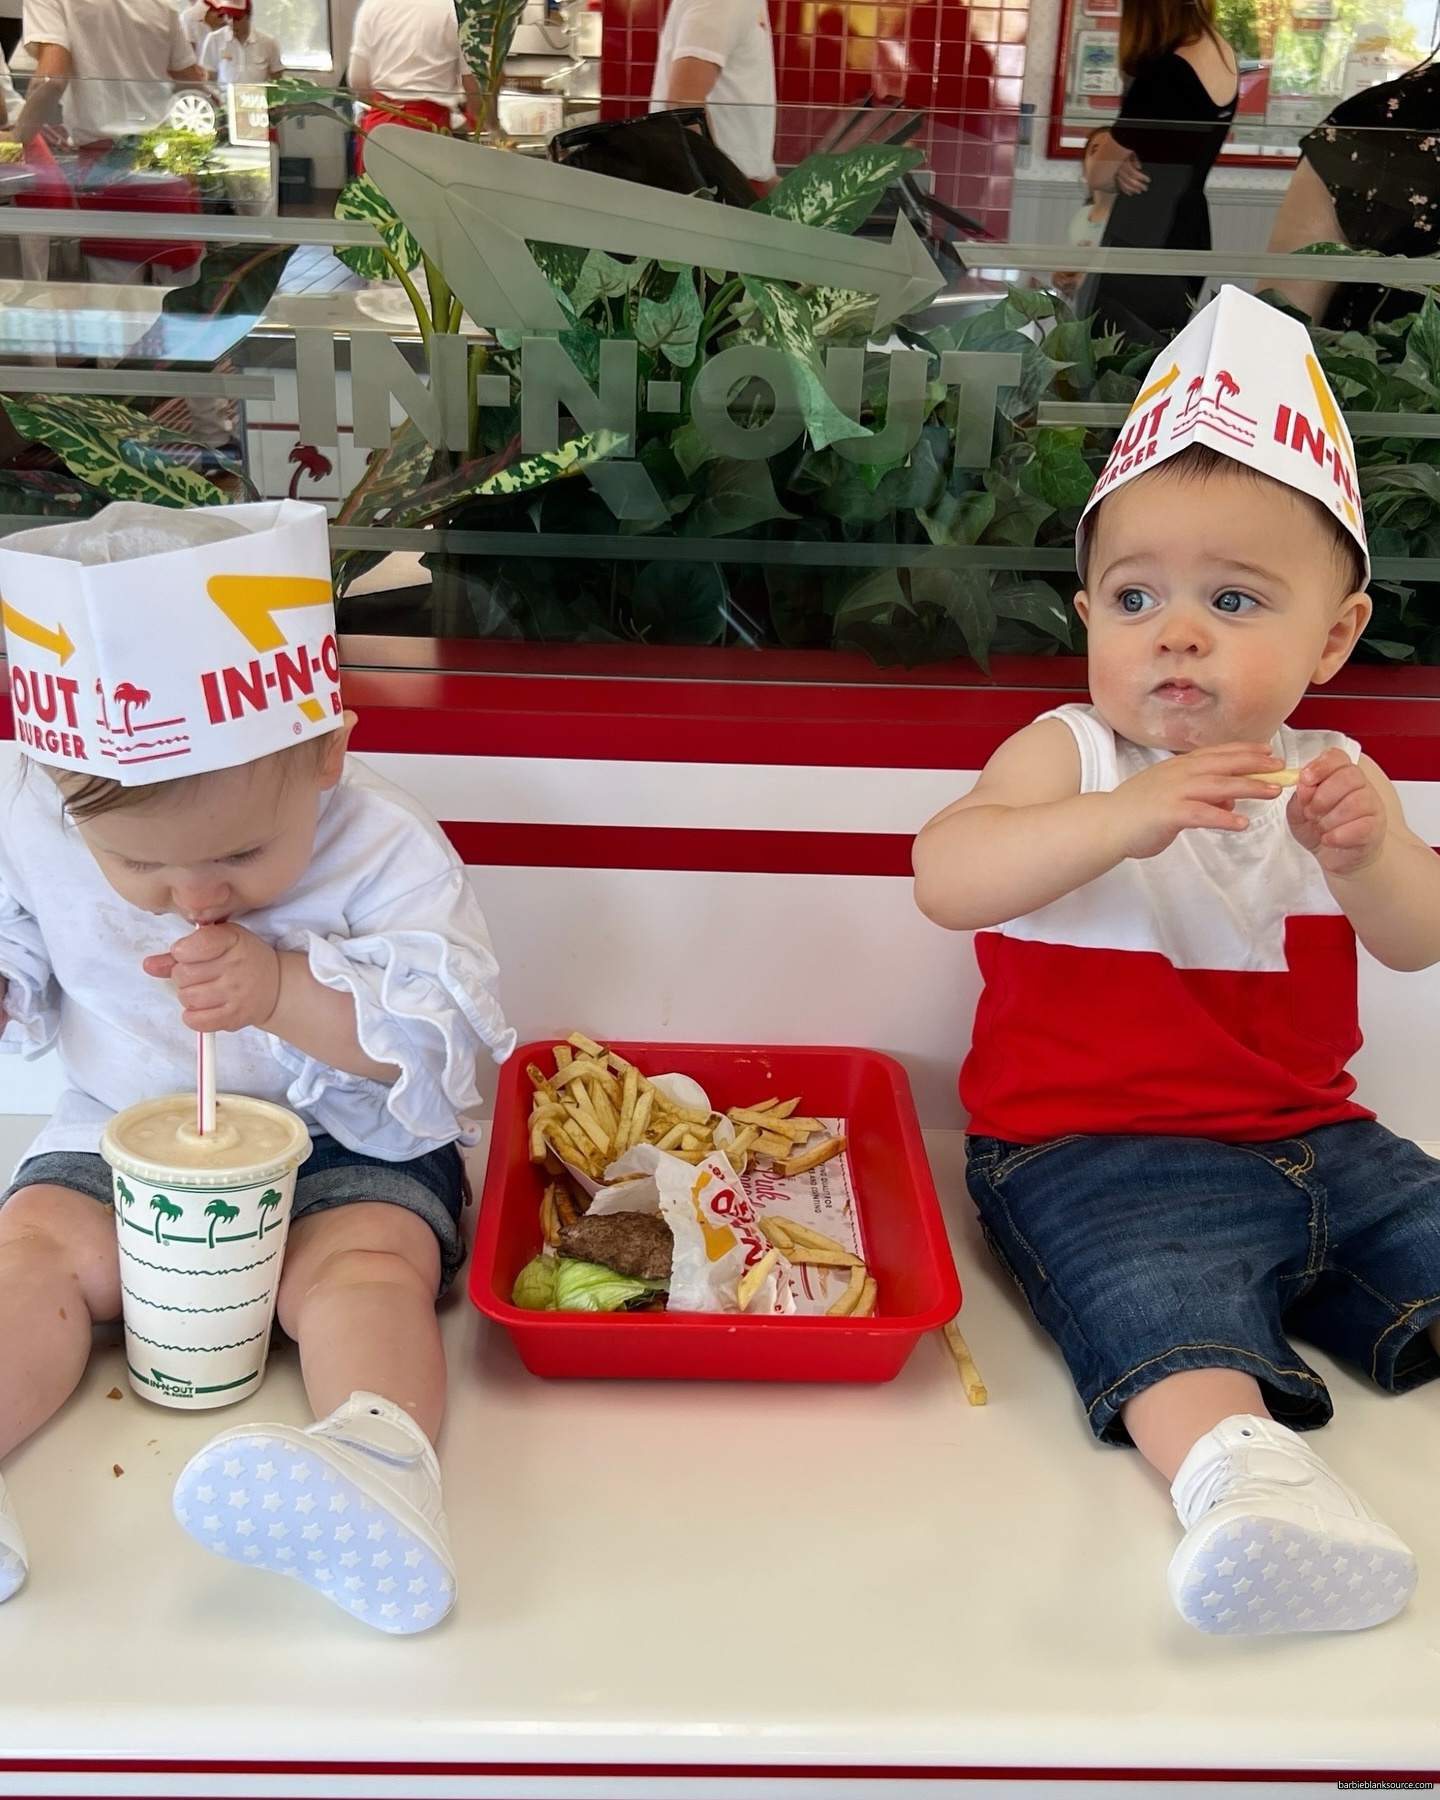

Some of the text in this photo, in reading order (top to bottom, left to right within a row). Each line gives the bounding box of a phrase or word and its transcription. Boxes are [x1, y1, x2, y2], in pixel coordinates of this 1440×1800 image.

[295, 327, 1023, 468] IN-N-OUT
[1273, 404, 1364, 522] IN-N-
[12, 665, 80, 729] OUT
[17, 717, 90, 761] BURGER
[150, 1379, 194, 1393] IN-N-OUT
